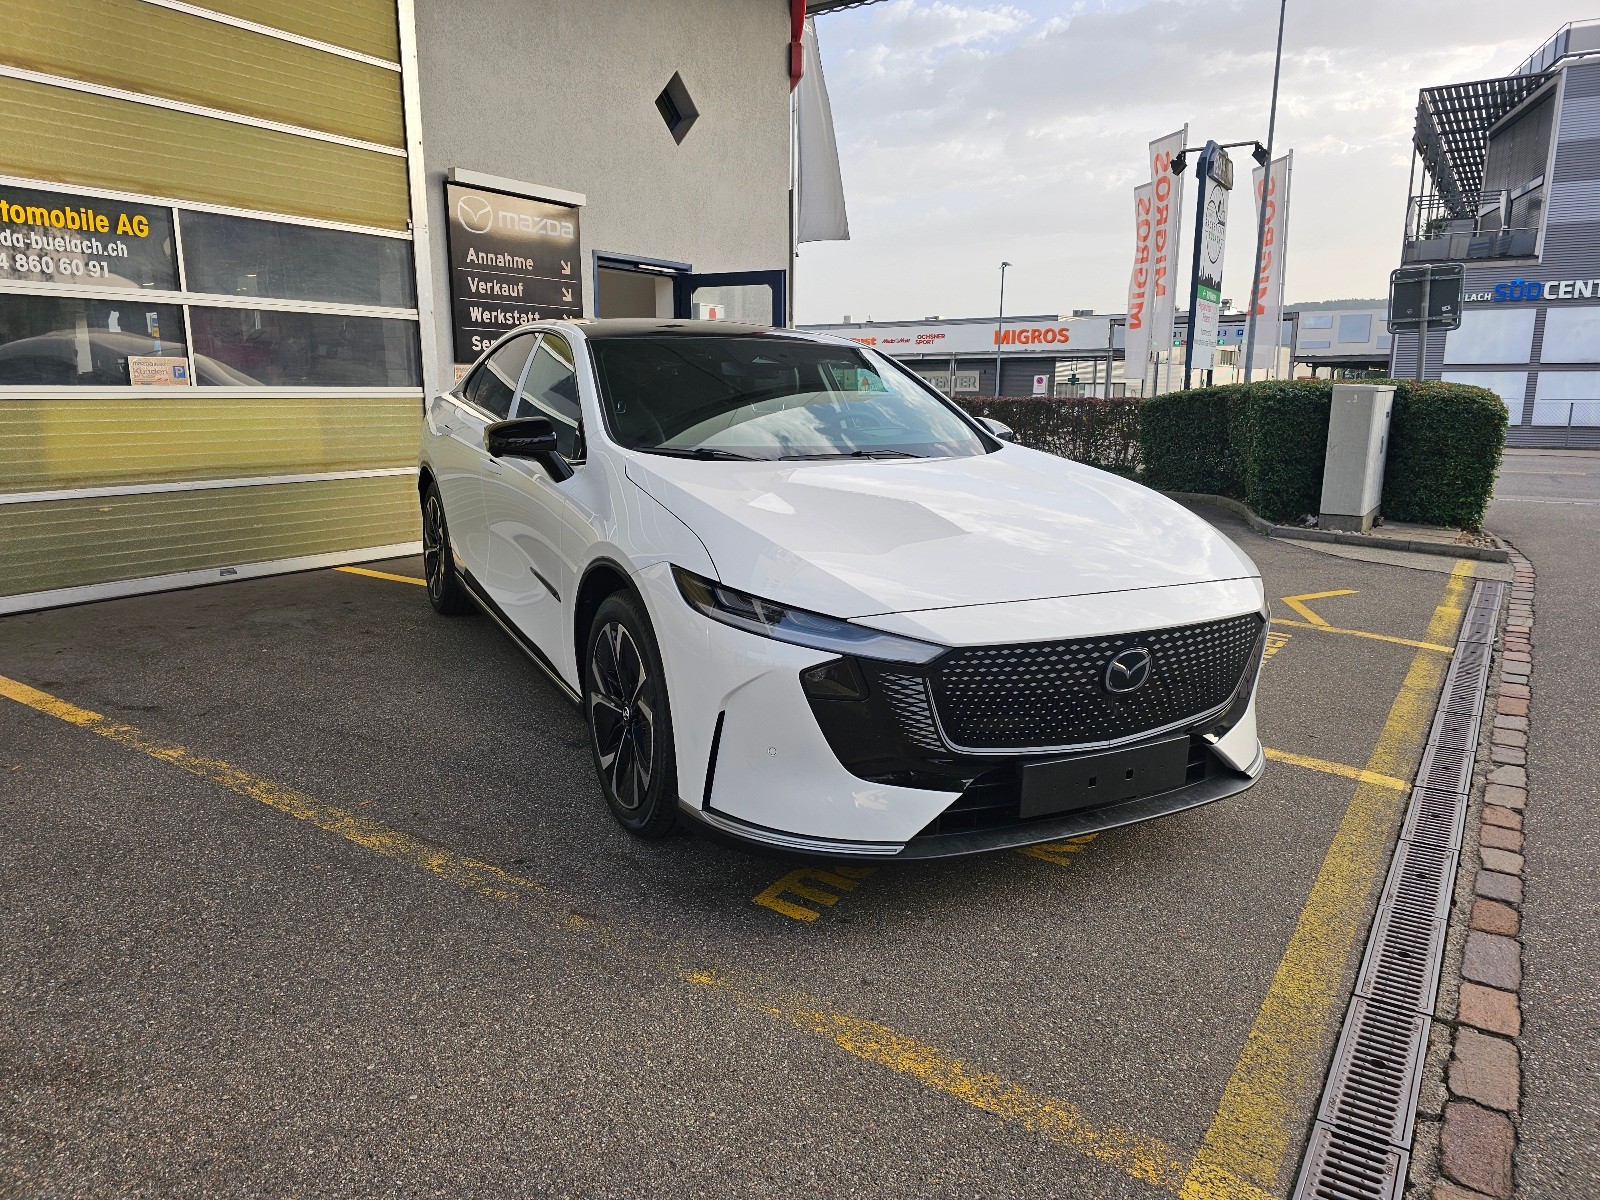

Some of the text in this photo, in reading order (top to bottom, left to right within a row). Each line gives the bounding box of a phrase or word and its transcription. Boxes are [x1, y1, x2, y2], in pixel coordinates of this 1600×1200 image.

[0, 199, 150, 238] tomobile AG
[0, 229, 128, 258] da-buelach.ch
[15, 253, 54, 274] 860
[59, 257, 84, 276] 60
[88, 260, 110, 278] 91
[466, 247, 534, 271] Annahme
[467, 276, 524, 297] Verkauf
[1458, 292, 1492, 303] LACH
[469, 306, 540, 326] Werkstatt
[850, 336, 877, 346] ust
[994, 327, 1070, 345] MIGROS
